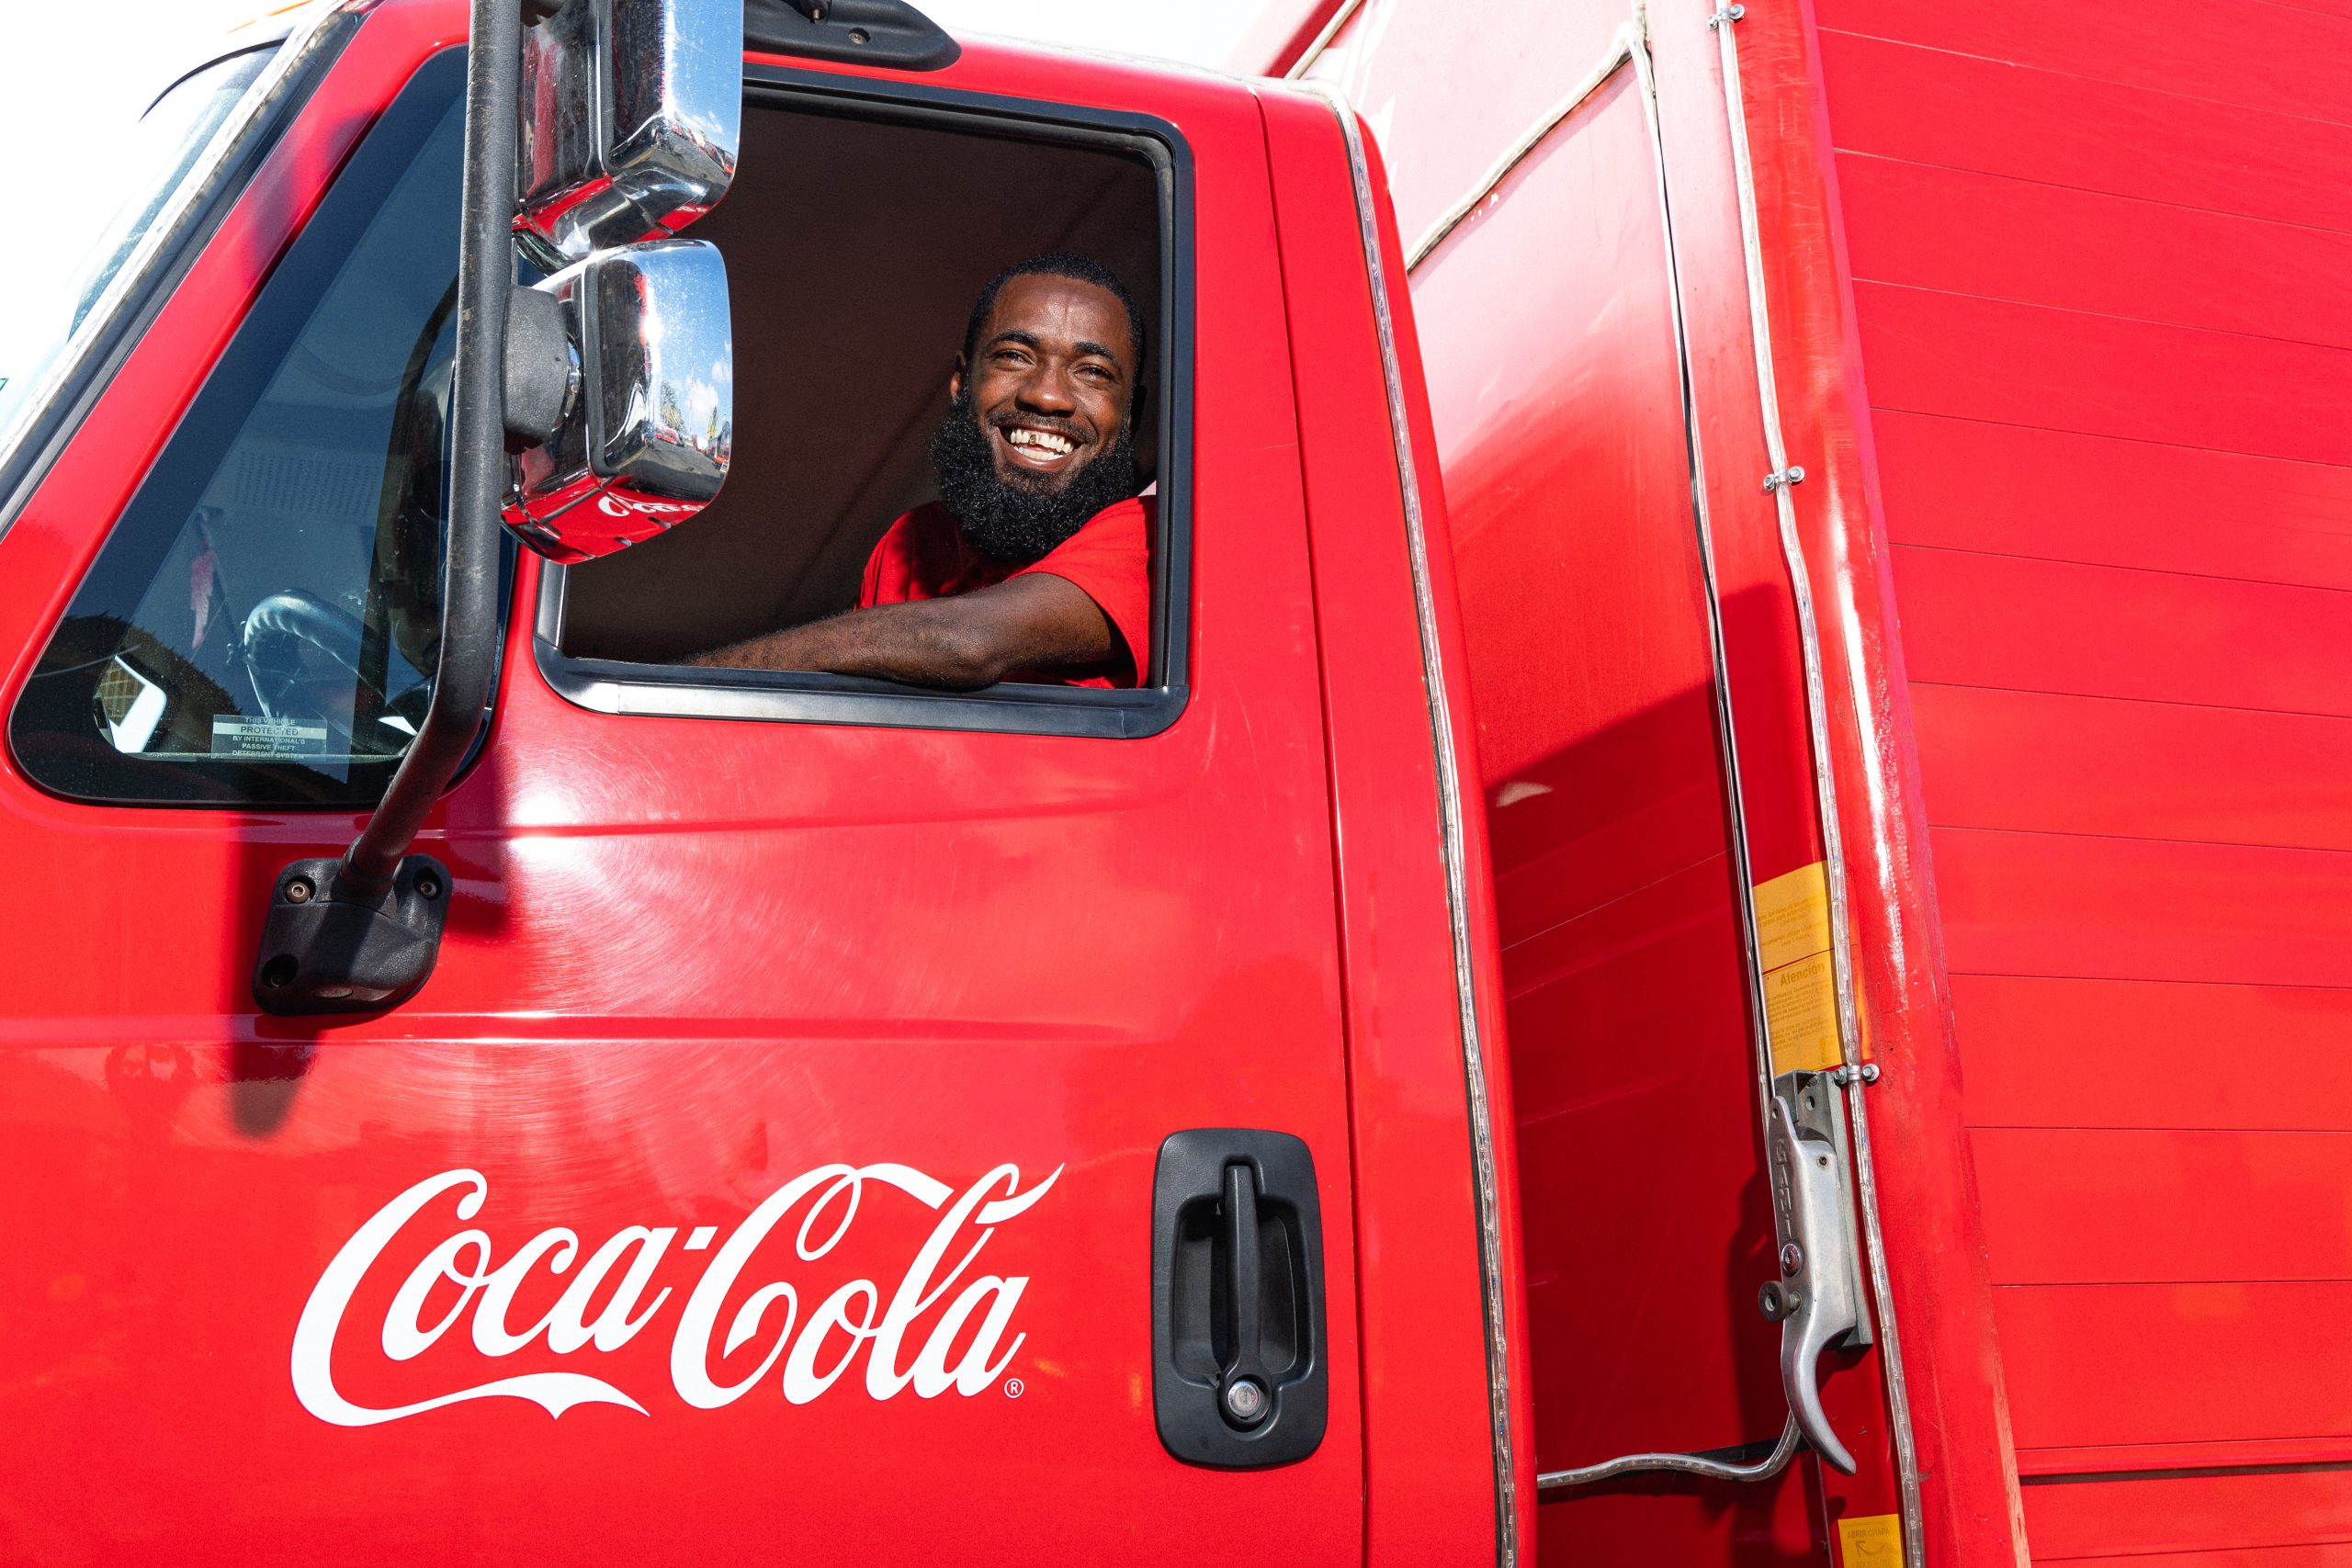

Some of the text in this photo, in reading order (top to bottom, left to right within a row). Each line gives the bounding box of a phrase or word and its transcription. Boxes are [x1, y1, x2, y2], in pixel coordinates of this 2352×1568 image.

[241, 726, 299, 736] PROTECTED
[242, 742, 272, 750] PASSIVE
[1780, 961, 1826, 987] Atención
[290, 1163, 1065, 1427] Coca-Cola
